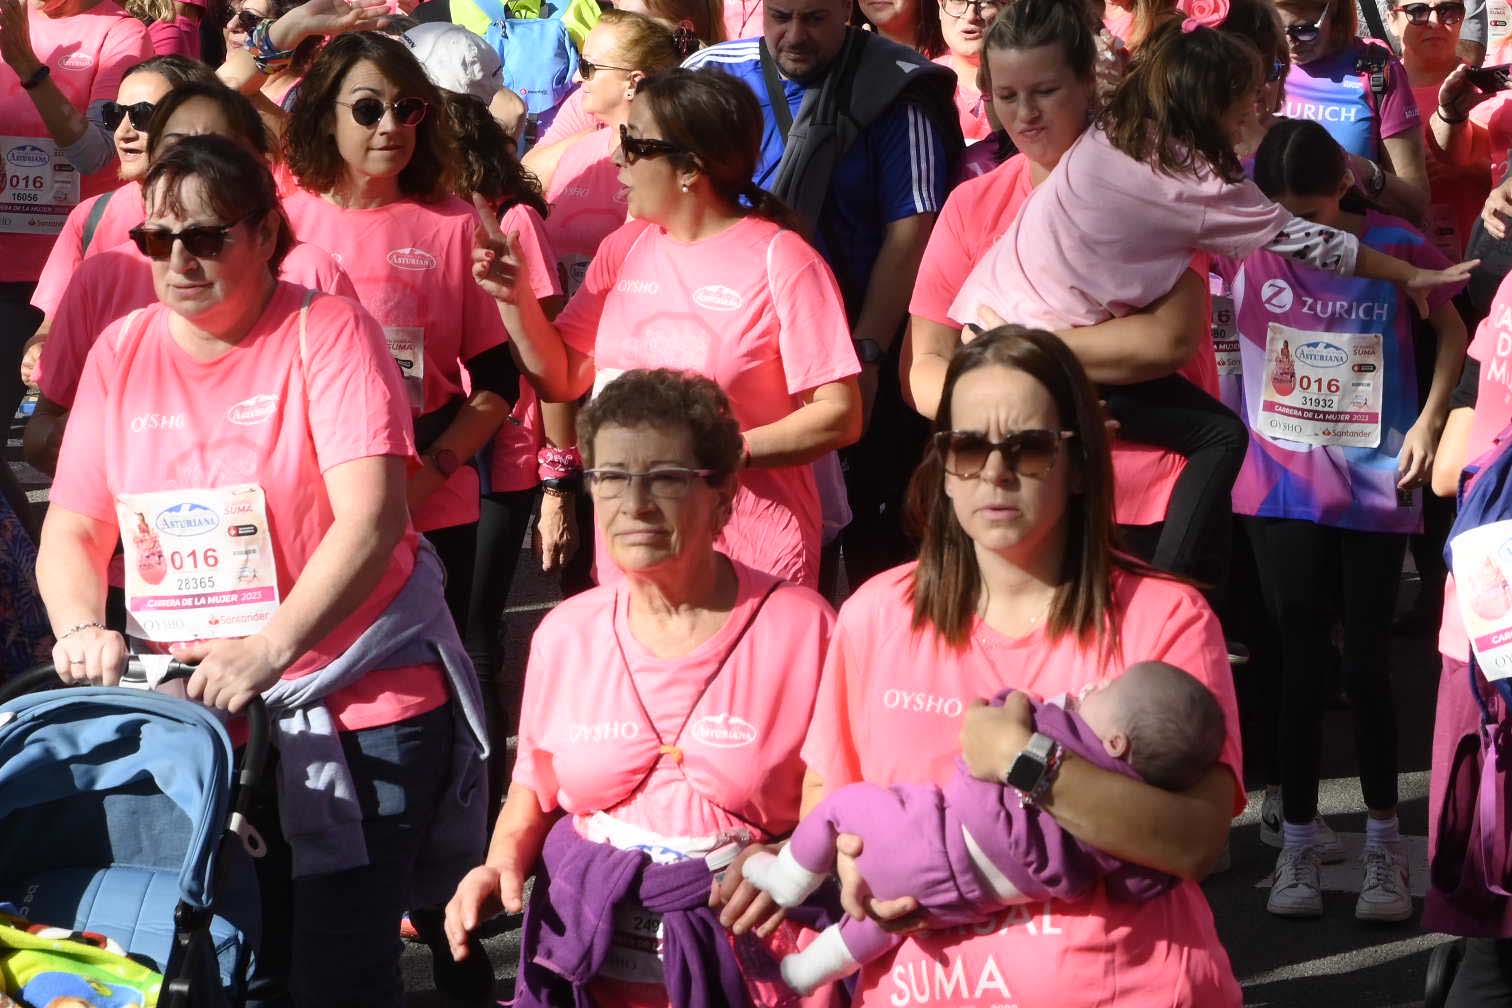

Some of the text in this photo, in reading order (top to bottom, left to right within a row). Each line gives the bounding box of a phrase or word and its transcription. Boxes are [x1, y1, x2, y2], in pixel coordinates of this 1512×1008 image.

[9, 174, 44, 189] 016
[12, 192, 38, 202] 16056
[618, 279, 659, 294] OYSHO
[1302, 297, 1389, 321] ZURICH
[1300, 348, 1344, 363] ASTURIANA
[1353, 348, 1376, 356] SUMA
[1300, 376, 1340, 394] 016
[1301, 396, 1334, 409] 31932
[1274, 405, 1302, 416] CARRERA
[1304, 410, 1312, 418] DE
[1315, 412, 1324, 420] LA
[1326, 412, 1350, 421] MUJER
[1270, 419, 1302, 433] OYSHO
[1332, 429, 1371, 438] Santander
[224, 505, 254, 515] SUMA
[161, 517, 216, 529] ASTURIANA
[170, 548, 219, 570] 016
[177, 576, 216, 592] 28365
[181, 598, 194, 606] DE
[195, 597, 207, 606] LA
[207, 594, 239, 605] MUJER
[144, 618, 185, 631] OYSHO
[220, 612, 270, 625] Santander
[883, 688, 963, 718] OYSHO
[890, 953, 1012, 1008] SUMA
